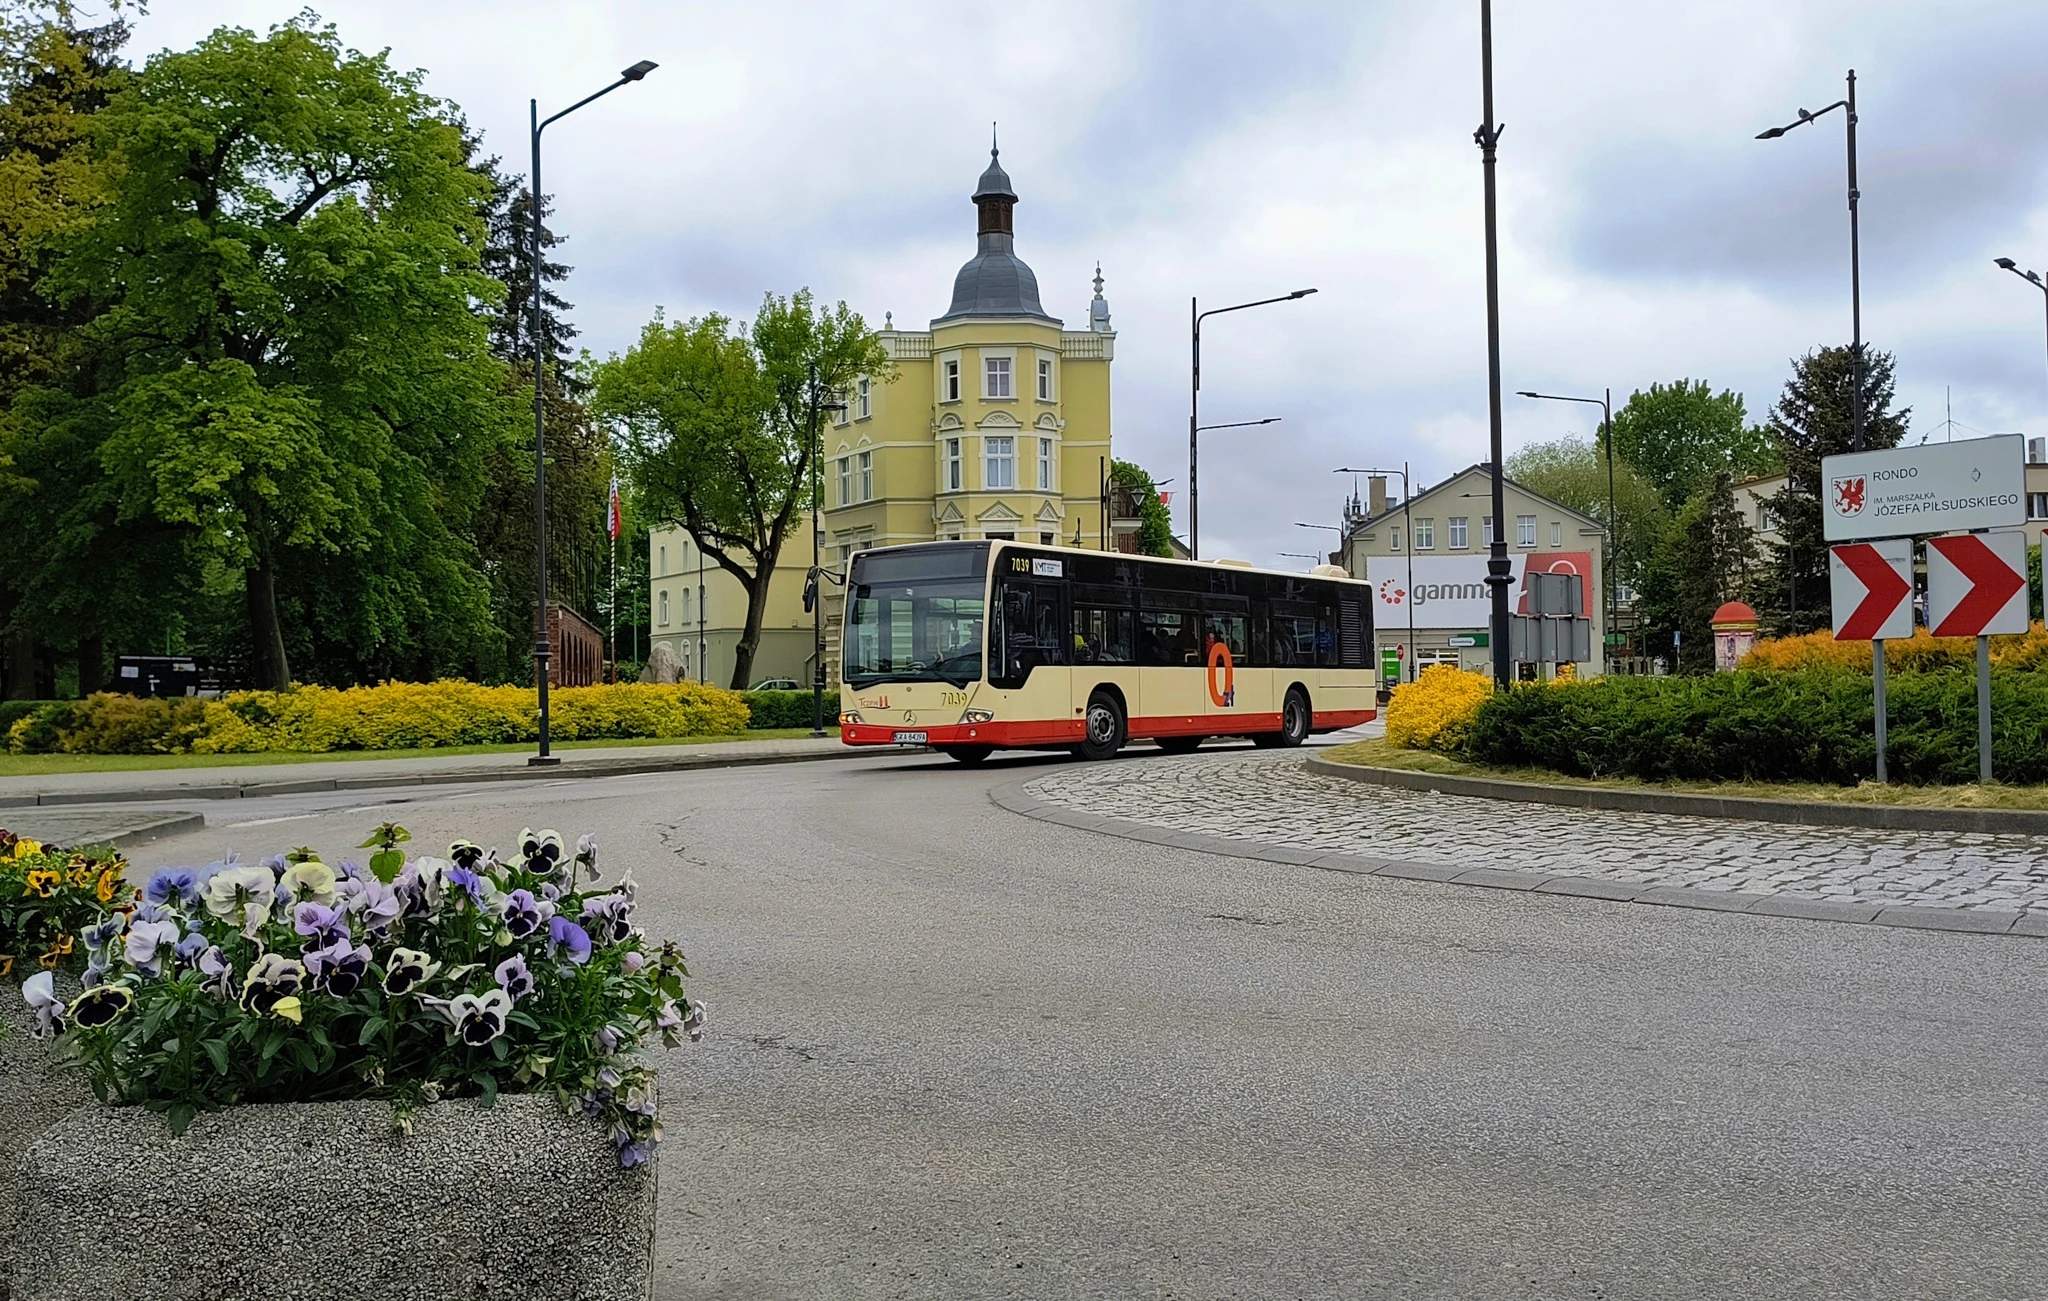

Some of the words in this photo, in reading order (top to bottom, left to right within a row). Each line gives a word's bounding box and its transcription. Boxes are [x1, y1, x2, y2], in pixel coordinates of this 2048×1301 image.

[1873, 467, 1918, 481] RONDO
[1873, 496, 1885, 504] IM.
[1887, 492, 1936, 503] MARSZAŁKA
[1874, 503, 1920, 517] JÓZEFA
[1923, 494, 2018, 512] PIŁSUDSKIEGO
[1011, 557, 1030, 572] 7039
[941, 692, 968, 707] 7039
